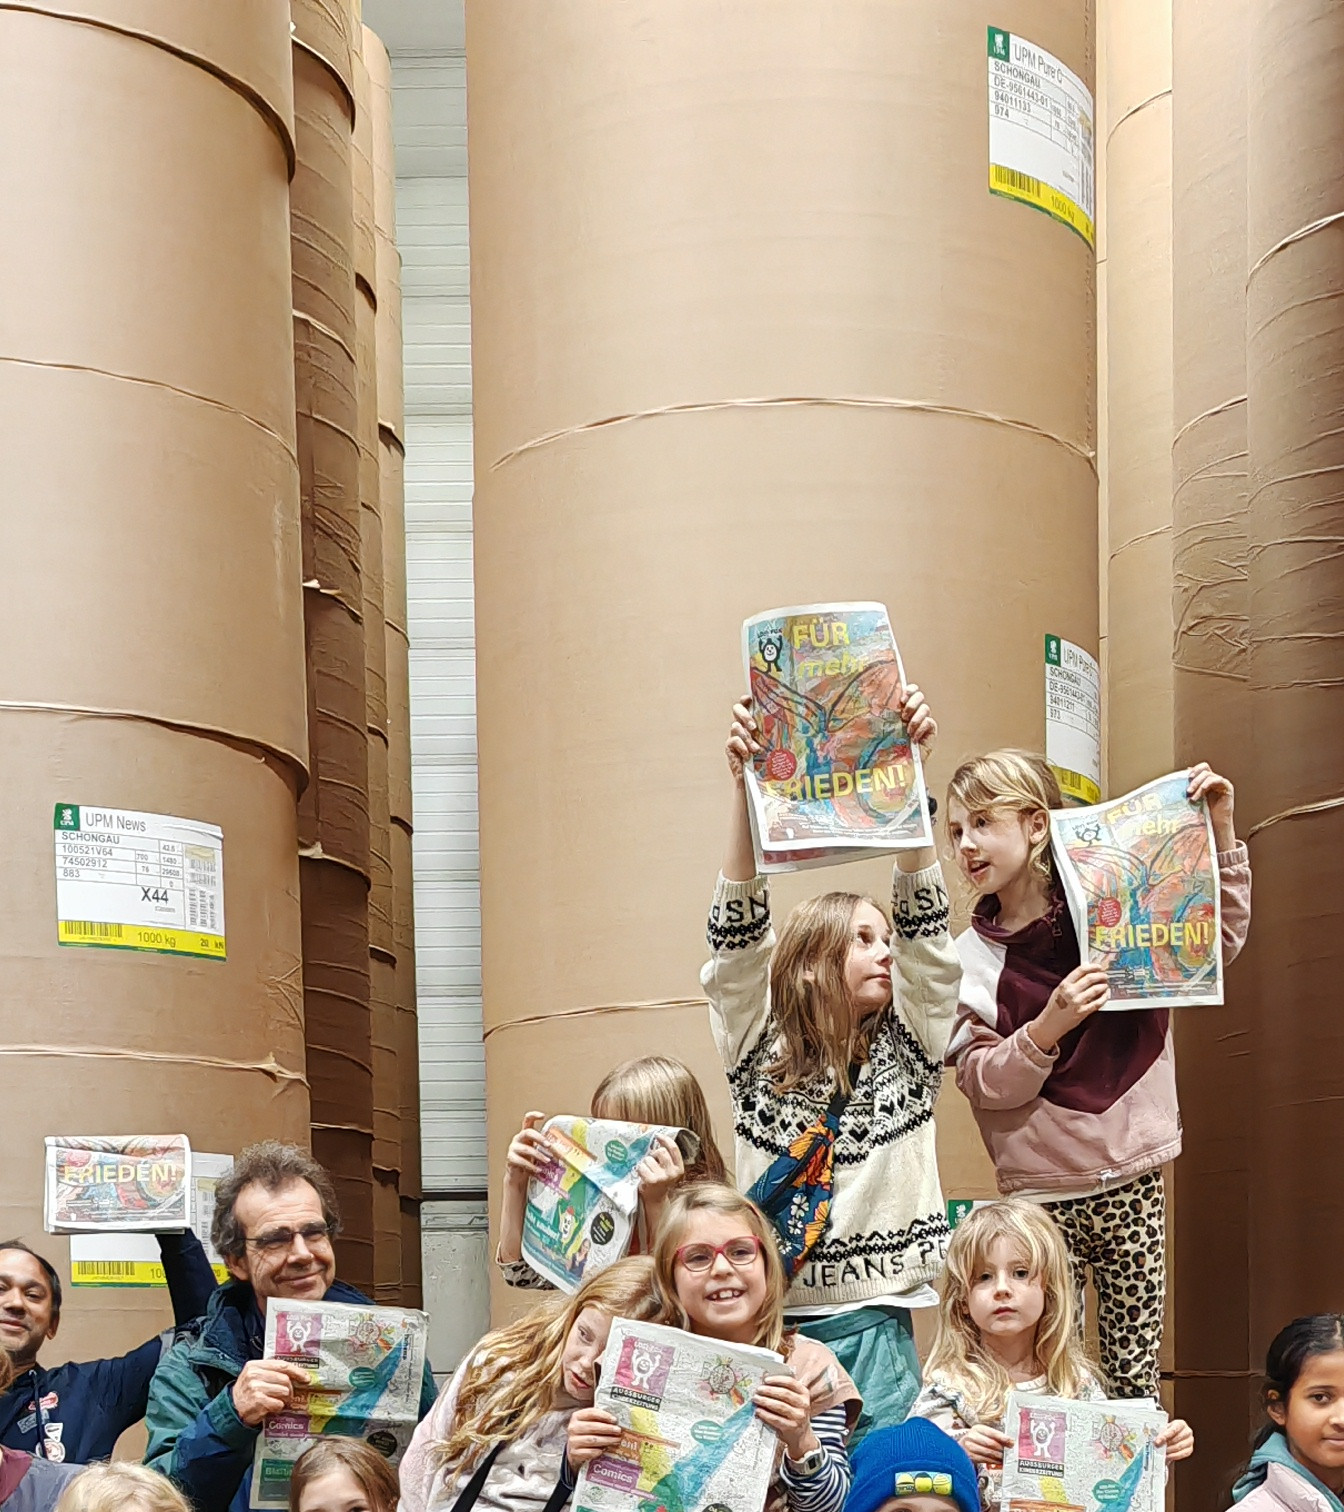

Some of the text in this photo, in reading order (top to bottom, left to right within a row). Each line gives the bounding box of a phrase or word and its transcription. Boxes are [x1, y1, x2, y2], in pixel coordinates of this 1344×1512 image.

[1014, 44, 1035, 67] UPM
[994, 61, 1041, 89] SCHONGAU
[792, 617, 850, 650] FÜR
[796, 655, 872, 679] mehr
[766, 764, 906, 802] FRIEDEN!
[1106, 793, 1162, 826] FÜR
[85, 813, 146, 832] UPM News
[62, 831, 120, 844] SCHONGAU
[62, 845, 113, 856] 100521V64
[62, 857, 107, 868] 74502912
[62, 869, 80, 878] 883
[141, 887, 168, 903] X44
[138, 931, 176, 948] 1000 kg
[1095, 922, 1209, 949] FRIEDEN!
[64, 1160, 177, 1184] FRIEDEN!
[803, 1253, 905, 1288] JEANS
[268, 1421, 303, 1431] Comics
[593, 1464, 633, 1484] Comics
